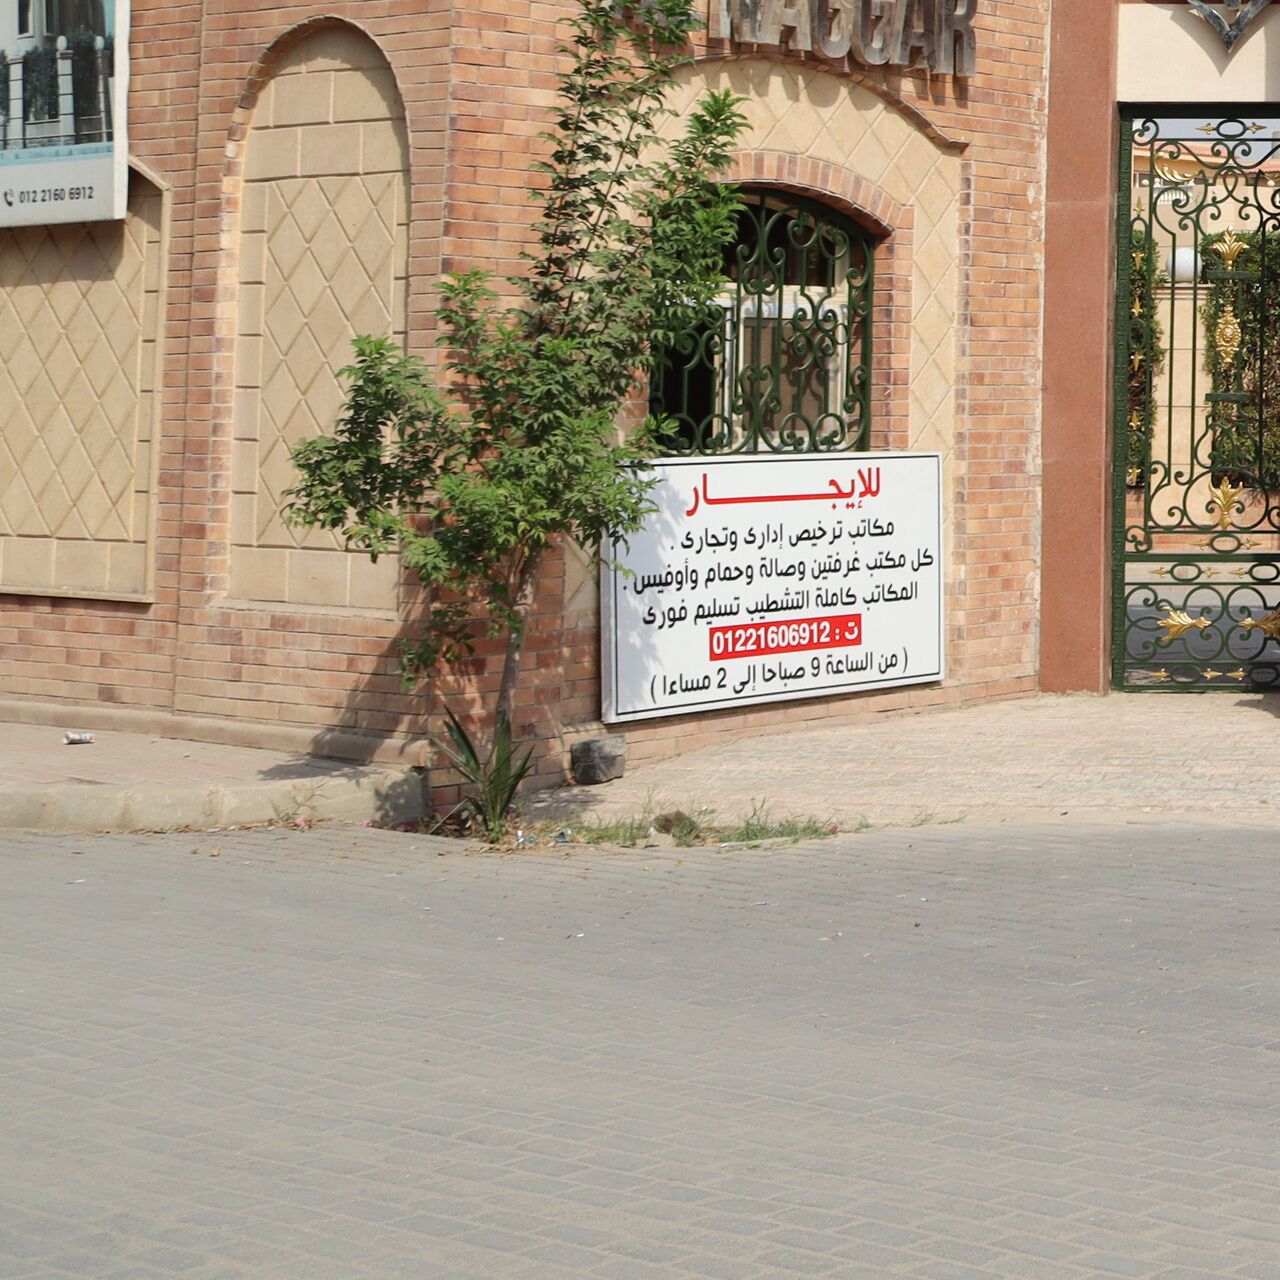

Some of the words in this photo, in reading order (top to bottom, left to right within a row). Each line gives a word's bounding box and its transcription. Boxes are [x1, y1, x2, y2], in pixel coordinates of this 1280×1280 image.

[19, 190, 38, 204] 012
[41, 188, 66, 202] 2160
[69, 186, 95, 201] 6912
[788, 520, 843, 547] ترخيص
[847, 518, 895, 545] مكاتب
[759, 557, 806, 581] وصالة
[811, 550, 861, 580] غرفتين
[866, 551, 906, 577] مكتب
[911, 548, 934, 572] كل
[633, 558, 699, 595] وأوفيس
[704, 563, 754, 589] وحمام
[745, 587, 810, 622] التشطيب
[815, 587, 857, 608] كاملة
[862, 581, 918, 611] المكاتب
[693, 596, 741, 626] تسليم
[712, 621, 831, 655] 01221606912
[762, 661, 806, 687] صباحا
[811, 657, 821, 677] 9
[825, 652, 873, 675] الساعة
[716, 667, 727, 689] 2
[733, 664, 757, 694] إلى
